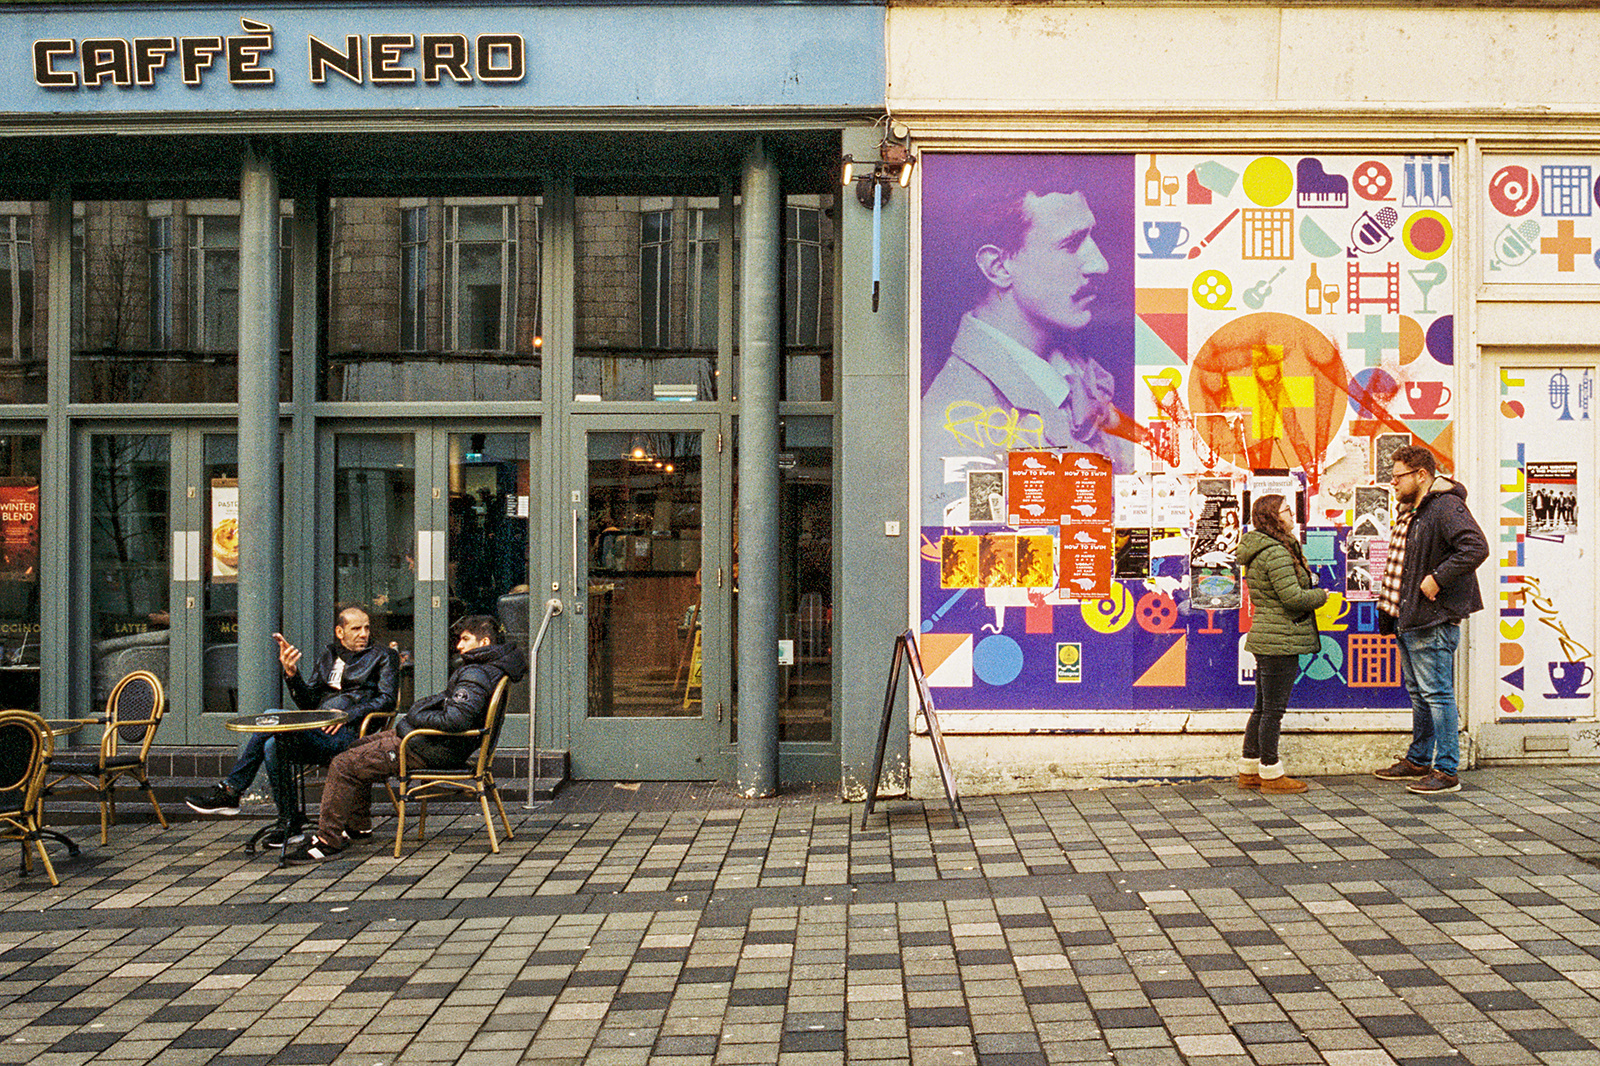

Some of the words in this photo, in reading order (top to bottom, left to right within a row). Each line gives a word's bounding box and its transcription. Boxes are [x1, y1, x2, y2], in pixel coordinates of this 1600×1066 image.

[32, 16, 276, 88] CAFFÈ
[308, 33, 526, 85] NERO
[1500, 370, 1525, 418] ST
[0, 502, 36, 511] WINTER
[2, 512, 33, 521] BLEND
[1500, 442, 1525, 713] SAUCHIEHALL
[115, 623, 148, 632] LATTE
